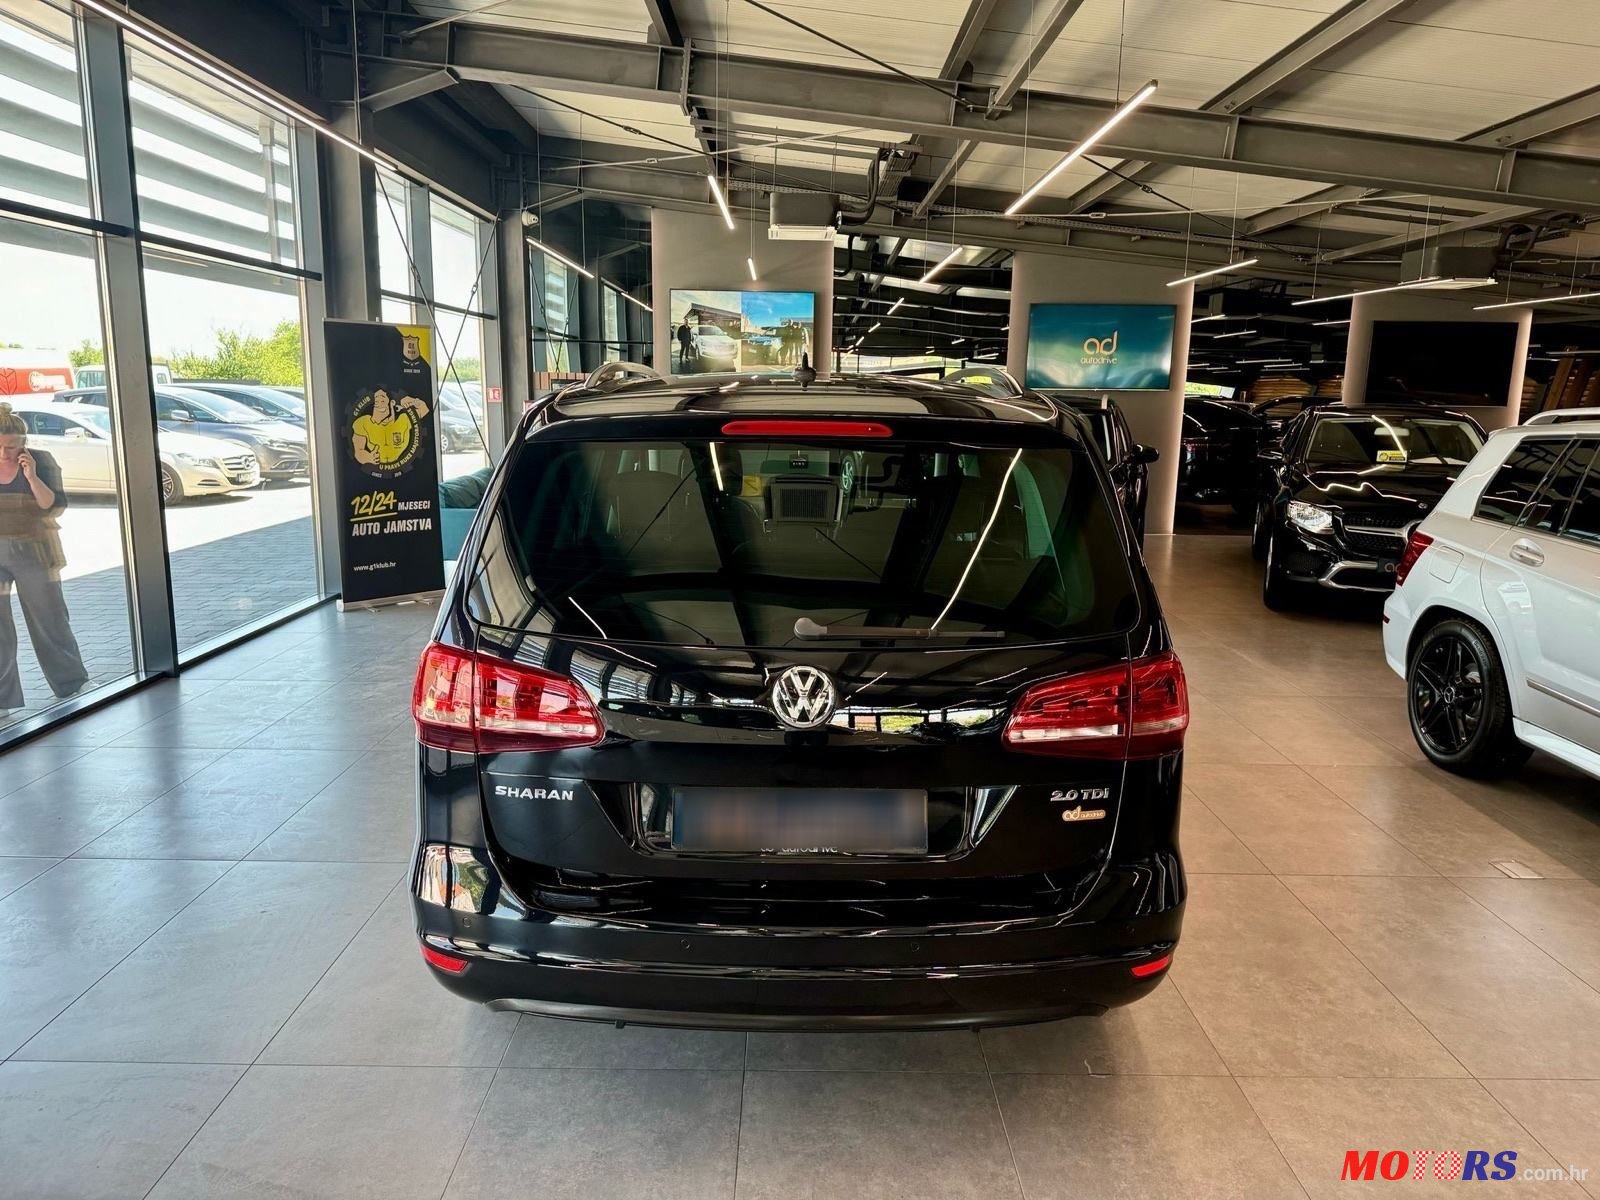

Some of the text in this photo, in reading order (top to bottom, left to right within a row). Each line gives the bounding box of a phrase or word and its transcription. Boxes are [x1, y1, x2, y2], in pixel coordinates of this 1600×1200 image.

[358, 396, 371, 409] KLUB
[351, 490, 431, 516] 12/24 MJESECI
[352, 518, 432, 537] AUTO JAMSTVA
[353, 561, 397, 572] www.g1klub.hr
[495, 785, 574, 801] SHARAN
